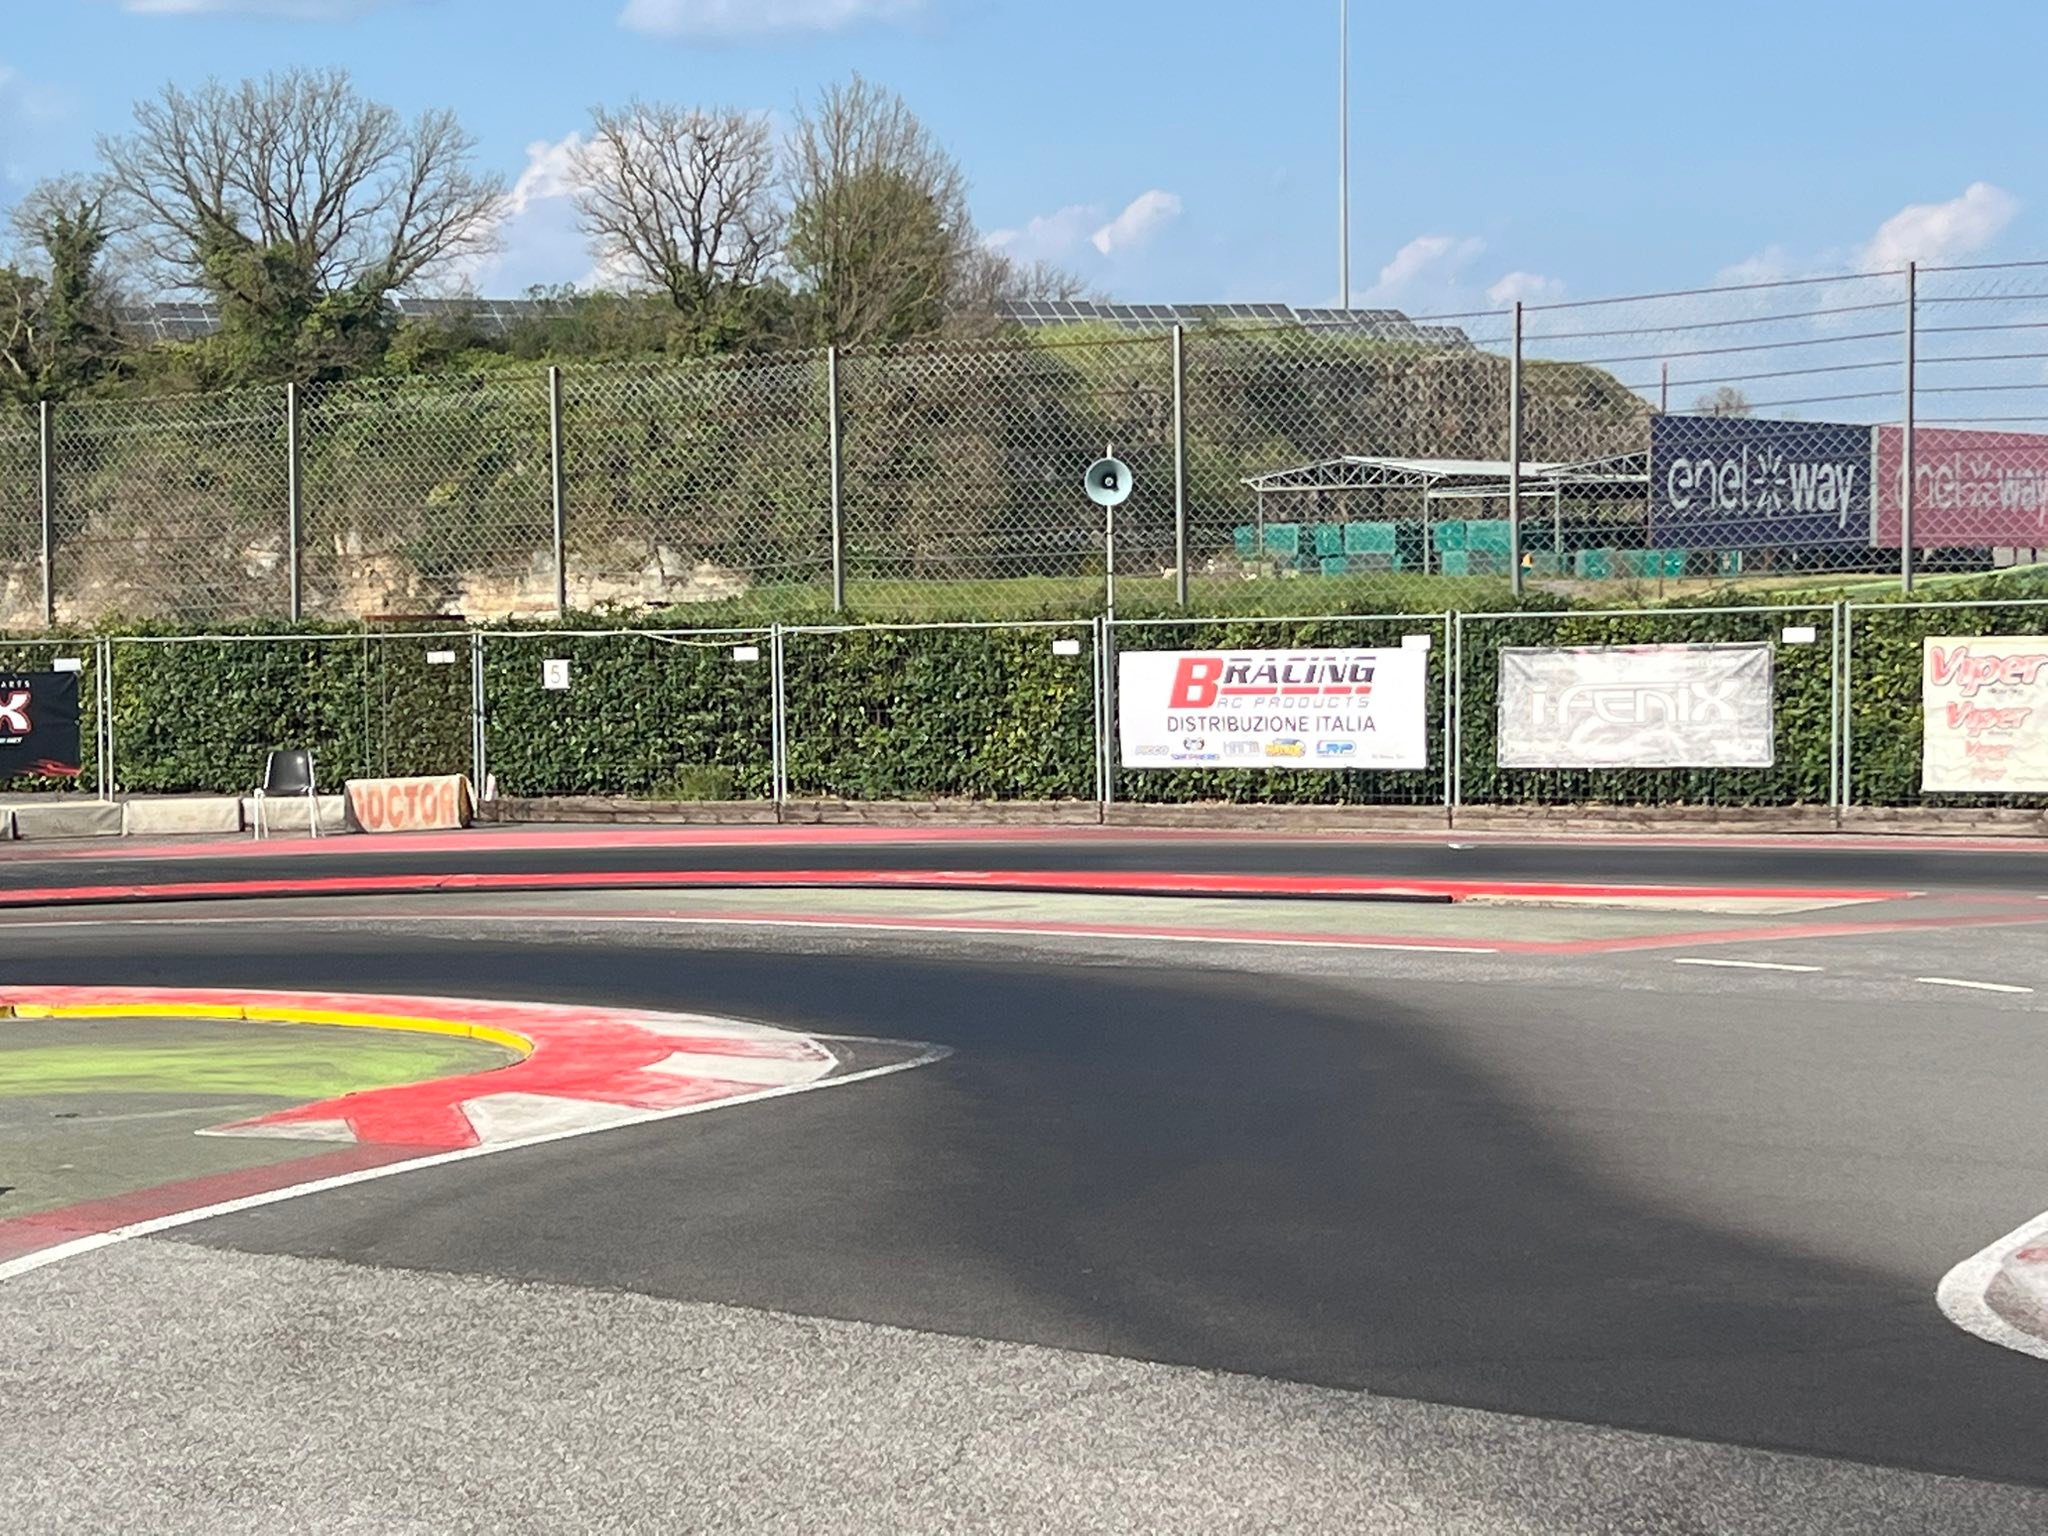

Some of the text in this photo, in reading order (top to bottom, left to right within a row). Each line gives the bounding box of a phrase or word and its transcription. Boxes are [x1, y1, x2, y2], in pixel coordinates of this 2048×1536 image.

[1668, 444, 1856, 529] enel way
[550, 664, 562, 684] 5
[1930, 646, 2048, 697] Viper
[1217, 696, 1371, 708] RC PRODUCTS
[1167, 714, 1376, 733] DISTRIBUZIONE ITALIA
[1946, 701, 2032, 737] Viper
